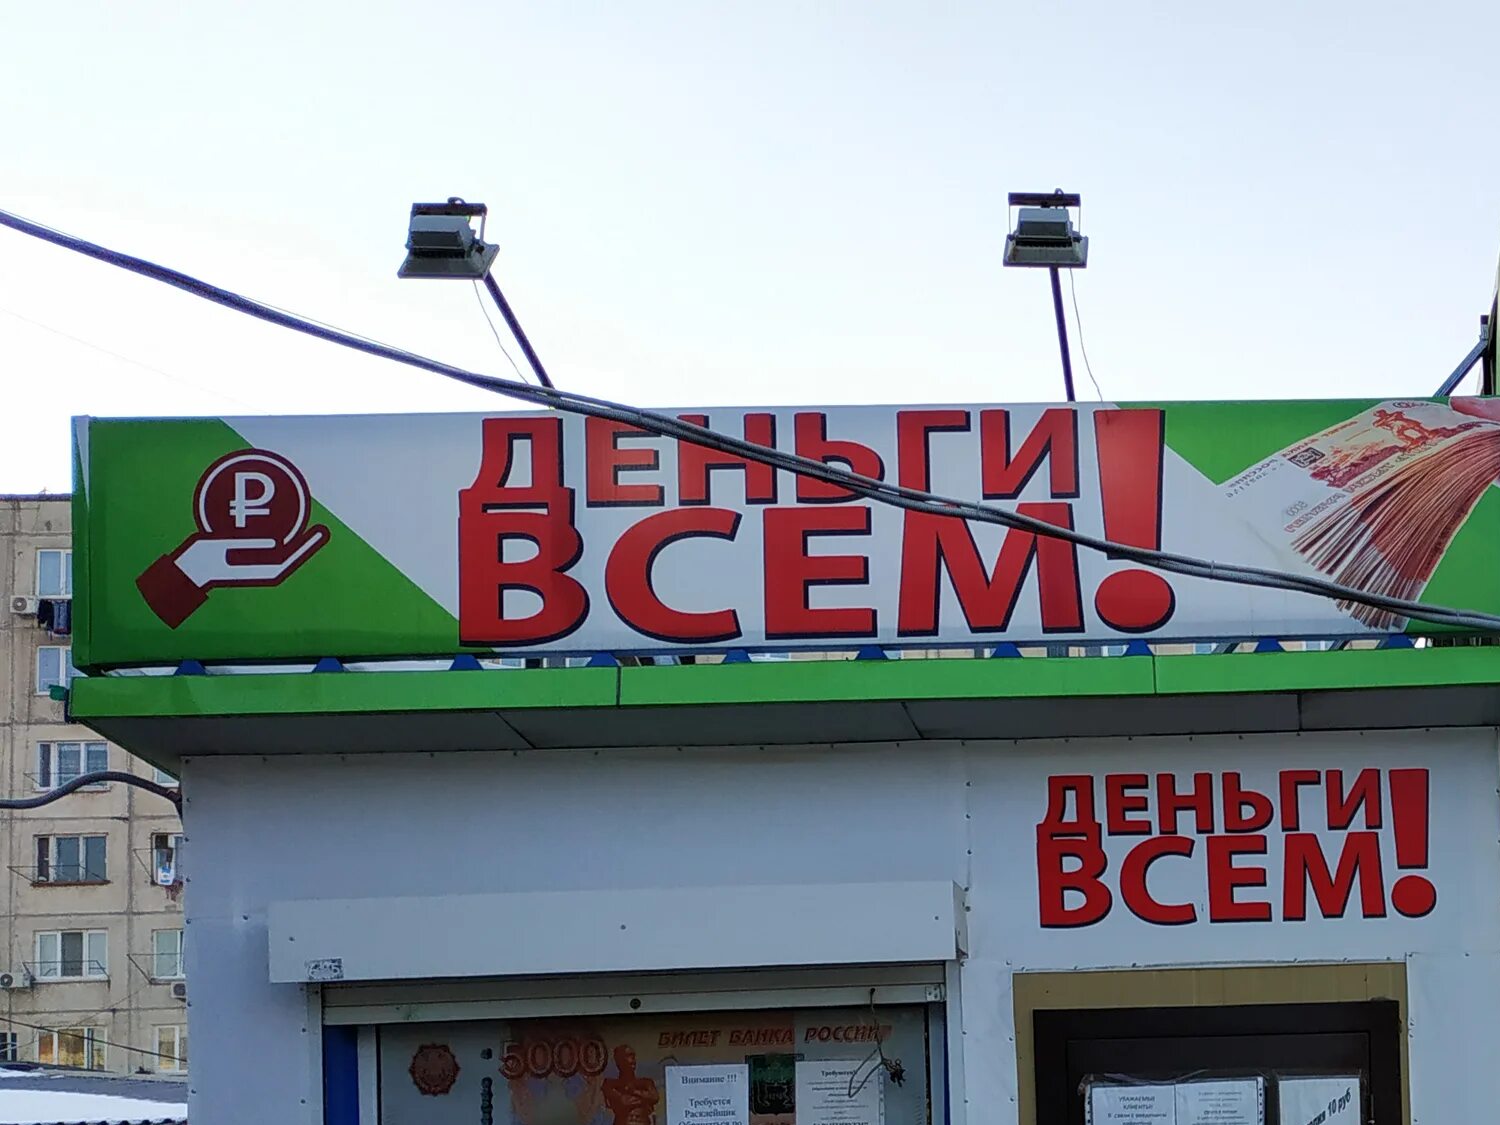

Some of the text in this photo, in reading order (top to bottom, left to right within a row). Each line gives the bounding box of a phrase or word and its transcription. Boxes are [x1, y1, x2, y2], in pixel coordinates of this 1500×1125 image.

[459, 407, 1081, 513] ДЕНЬГИ
[458, 408, 1175, 647] ВСЕМ!
[1037, 768, 1383, 837] ДЕНЬГИ
[1036, 768, 1437, 928] ВСЕМ!
[500, 1037, 608, 1078] 5000
[658, 1030, 721, 1047] БИЛЕТ
[728, 1027, 794, 1046] БАНКА
[681, 1075, 725, 1084] Внимание
[688, 1098, 731, 1108] Требуется
[1328, 1098, 1337, 1117] 10
[1338, 1087, 1352, 1113] руб
